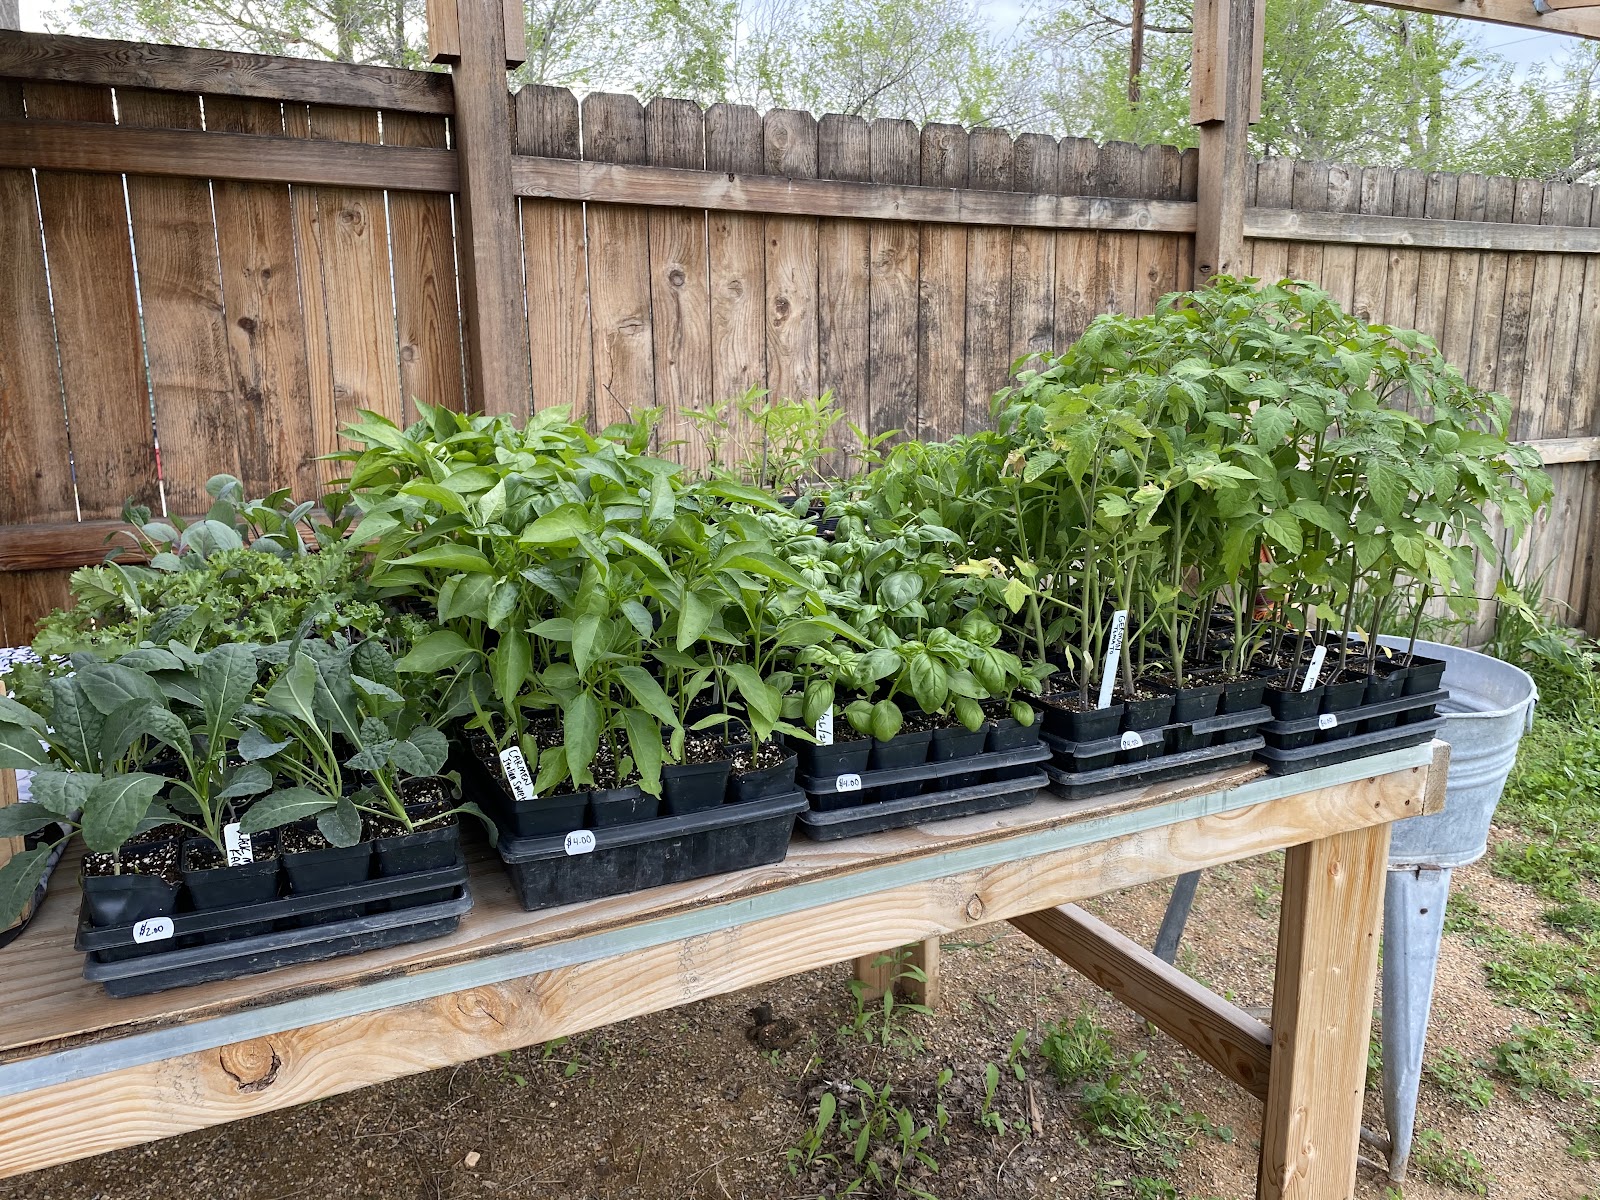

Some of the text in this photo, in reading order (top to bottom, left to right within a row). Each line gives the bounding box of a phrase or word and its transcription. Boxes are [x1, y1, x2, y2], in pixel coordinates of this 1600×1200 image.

[508, 749, 533, 786] CARMEN
[838, 777, 860, 789] $4.00
[566, 835, 592, 849] $4.00
[139, 921, 164, 937] $2.00
